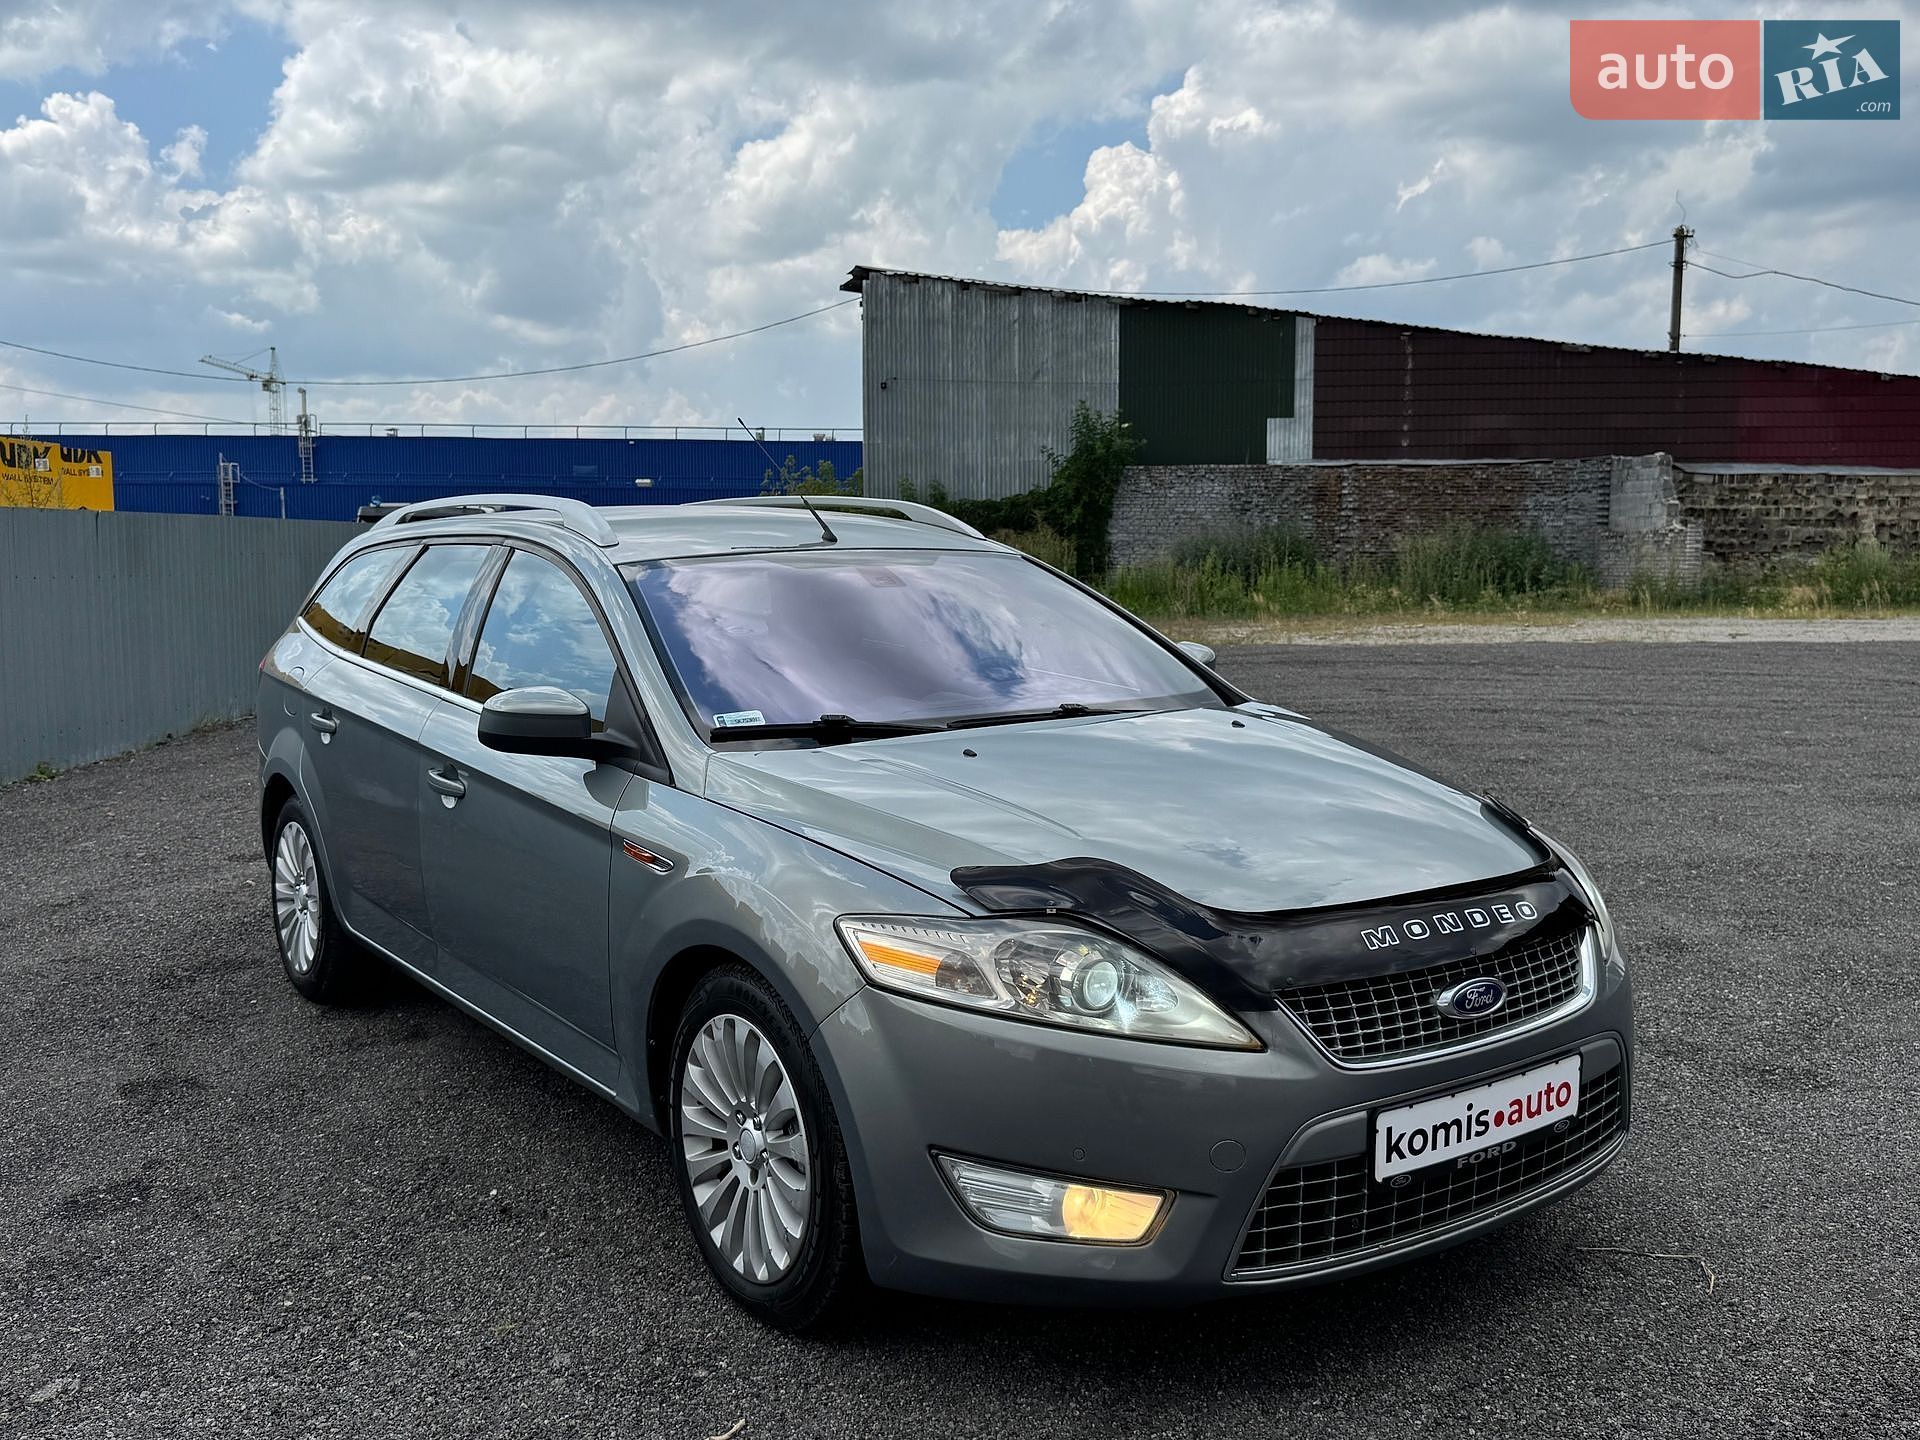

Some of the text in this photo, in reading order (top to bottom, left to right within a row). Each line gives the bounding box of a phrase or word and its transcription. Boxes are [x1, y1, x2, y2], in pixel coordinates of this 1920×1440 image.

[1360, 901, 1538, 950] MONDEO
[1465, 986, 1494, 1009] Ford
[1457, 1140, 1517, 1169] FORD
